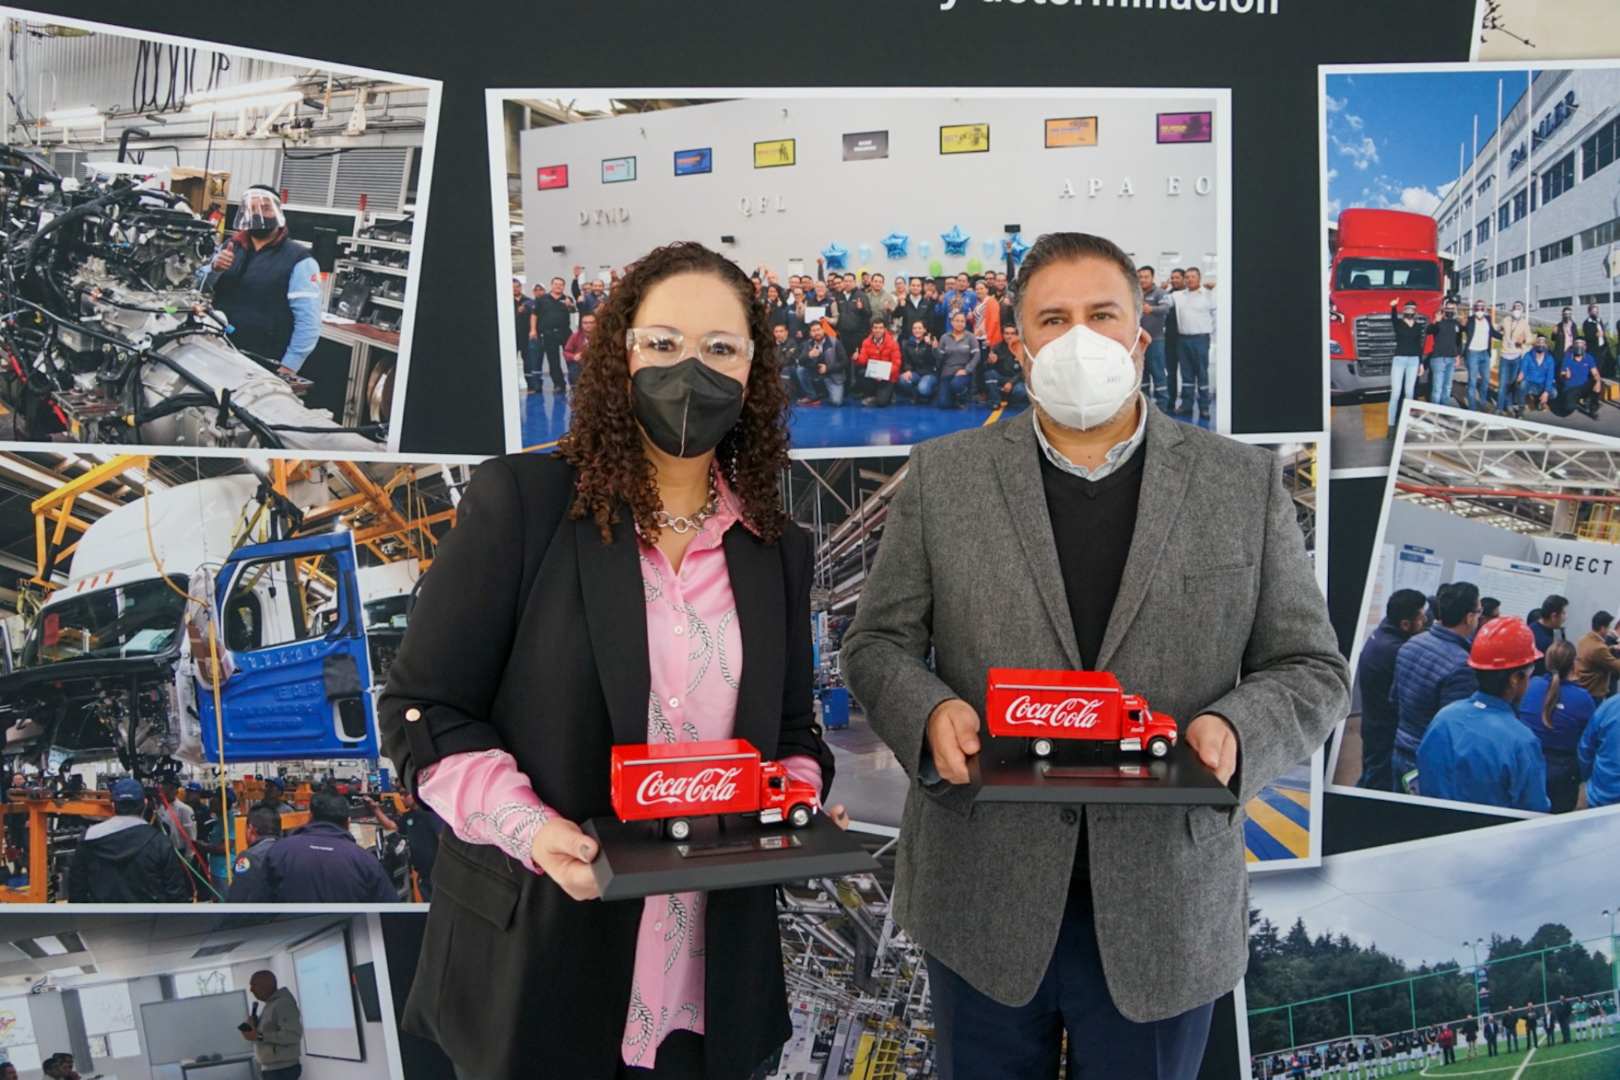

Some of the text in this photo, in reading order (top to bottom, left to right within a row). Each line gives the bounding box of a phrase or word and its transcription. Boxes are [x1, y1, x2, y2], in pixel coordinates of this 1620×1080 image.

[1542, 551, 1613, 575] DIRECT
[1005, 695, 1103, 728] Coca-Cola
[636, 767, 742, 805] Coca-Cola
